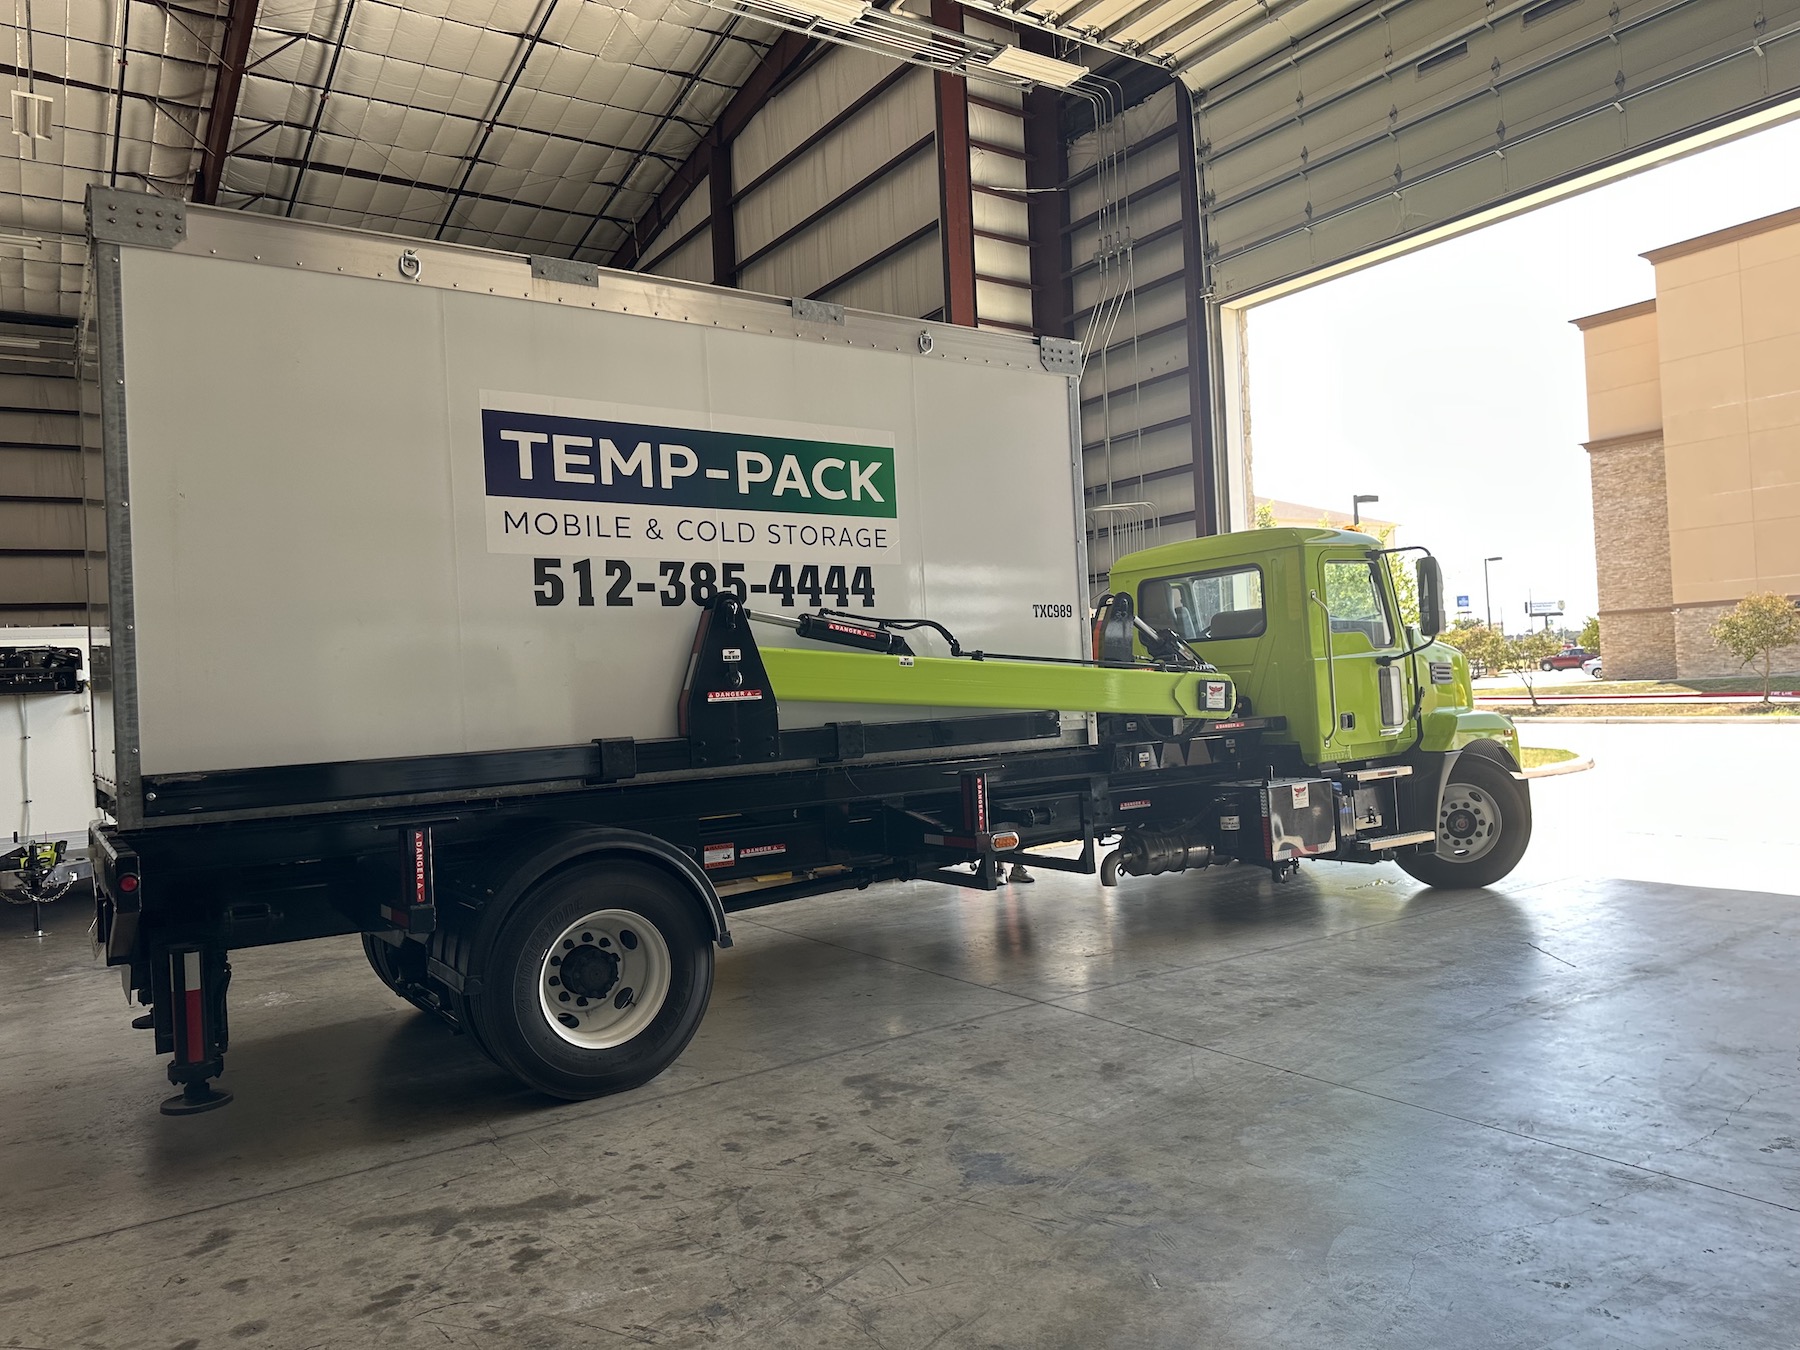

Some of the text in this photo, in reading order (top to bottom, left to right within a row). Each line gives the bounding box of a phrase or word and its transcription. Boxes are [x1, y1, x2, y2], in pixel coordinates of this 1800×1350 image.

[500, 429, 886, 503] TEMP-PACK
[504, 510, 888, 549] MOBILE & COLD STORAGE
[533, 557, 875, 608] 512-385-4444
[1032, 603, 1073, 619] TXC989
[834, 624, 862, 635] DANGER
[715, 690, 745, 698] DANGER
[415, 842, 424, 880] DANGER
[746, 846, 772, 854] DANGER
